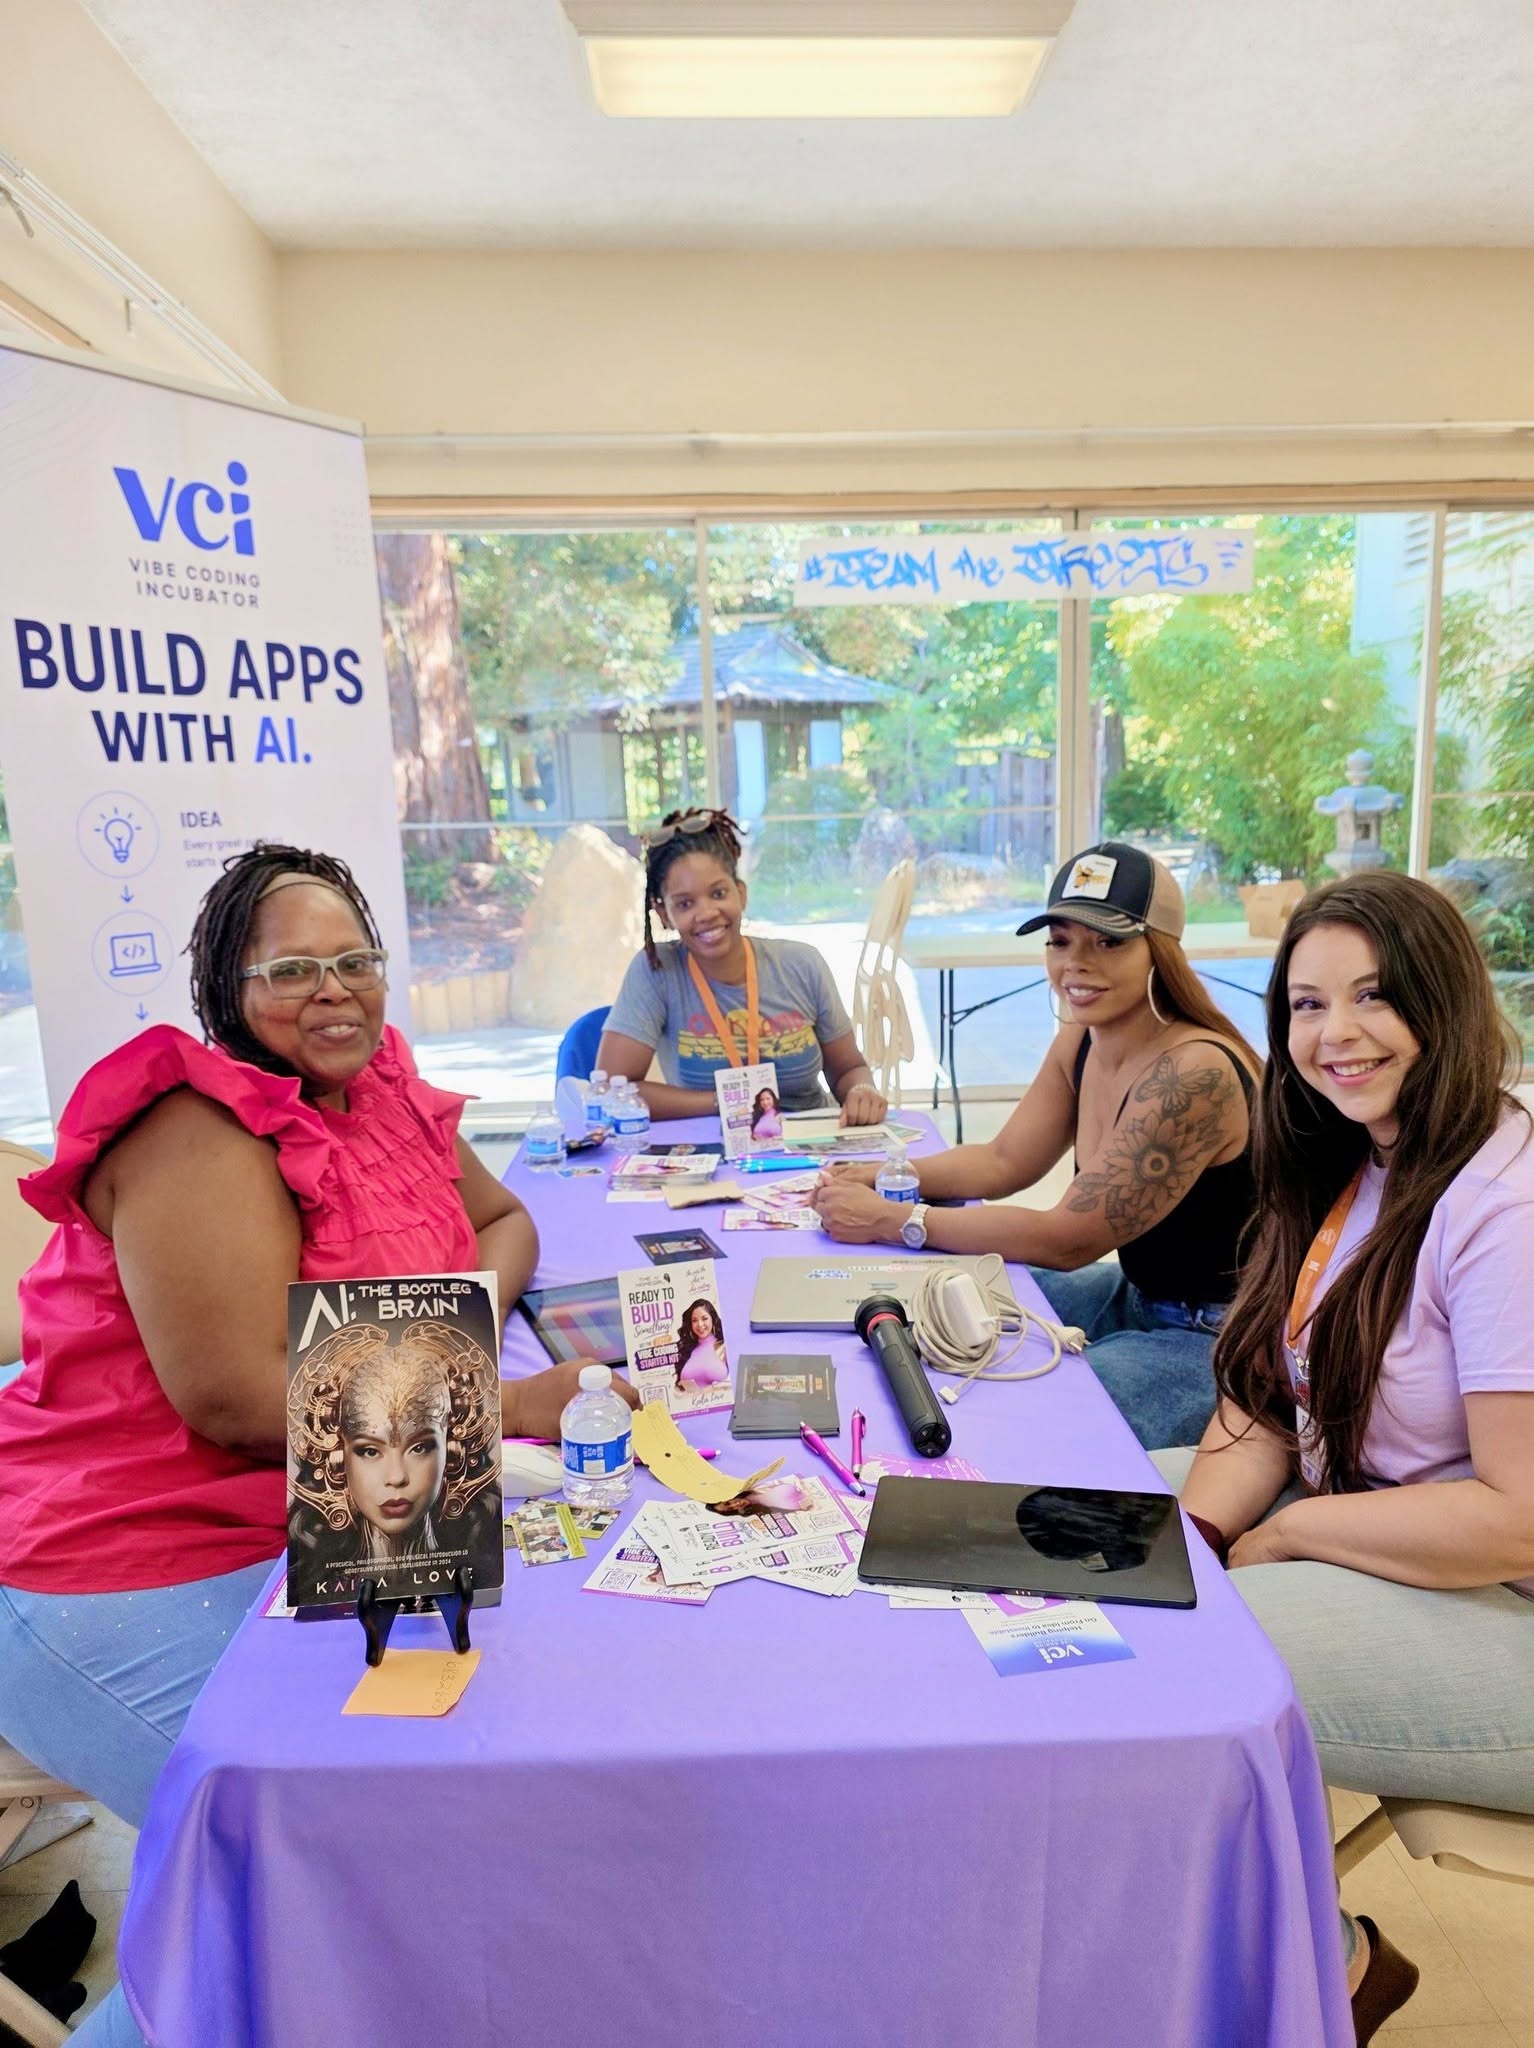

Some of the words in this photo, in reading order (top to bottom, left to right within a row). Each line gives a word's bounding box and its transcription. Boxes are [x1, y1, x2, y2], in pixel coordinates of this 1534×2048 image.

[129, 557, 176, 578] VIBE
[186, 565, 260, 588] CODING
[136, 581, 259, 608] INCUBATOR
[15, 619, 206, 696] BUILD
[230, 639, 363, 705] APPS
[91, 710, 235, 762] WITH
[255, 716, 312, 763] AI.
[180, 811, 221, 827] IDEA
[629, 1289, 660, 1305] READY
[662, 1287, 674, 1300] TO
[297, 1284, 357, 1353] AI:
[358, 1285, 392, 1298] THE
[399, 1282, 471, 1296] BOOTLEG
[378, 1297, 459, 1320] BRAIN
[631, 1301, 674, 1325] BUILD
[640, 1357, 668, 1369] STARTER
[316, 1577, 388, 1595] KAIA
